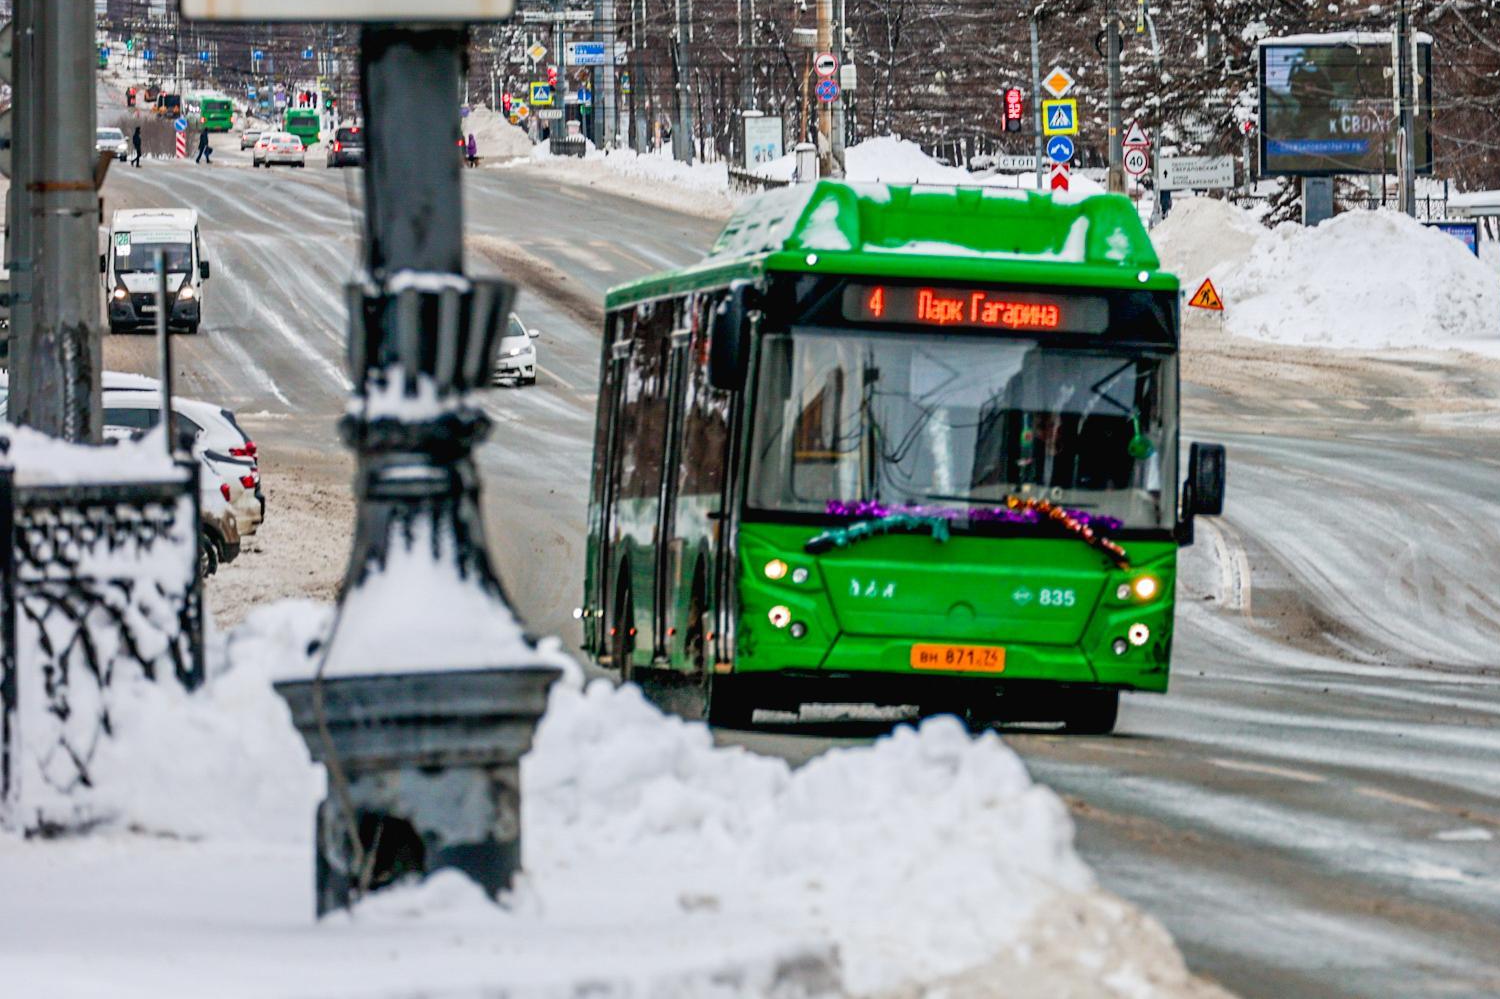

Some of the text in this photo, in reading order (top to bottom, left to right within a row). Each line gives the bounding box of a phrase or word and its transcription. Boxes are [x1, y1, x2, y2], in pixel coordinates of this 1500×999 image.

[1002, 159, 1034, 167] СТОП
[1129, 156, 1143, 167] 40
[869, 287, 1059, 328] 4 Парк Гагарина
[1039, 589, 1075, 606] 835
[945, 648, 974, 665] 871
